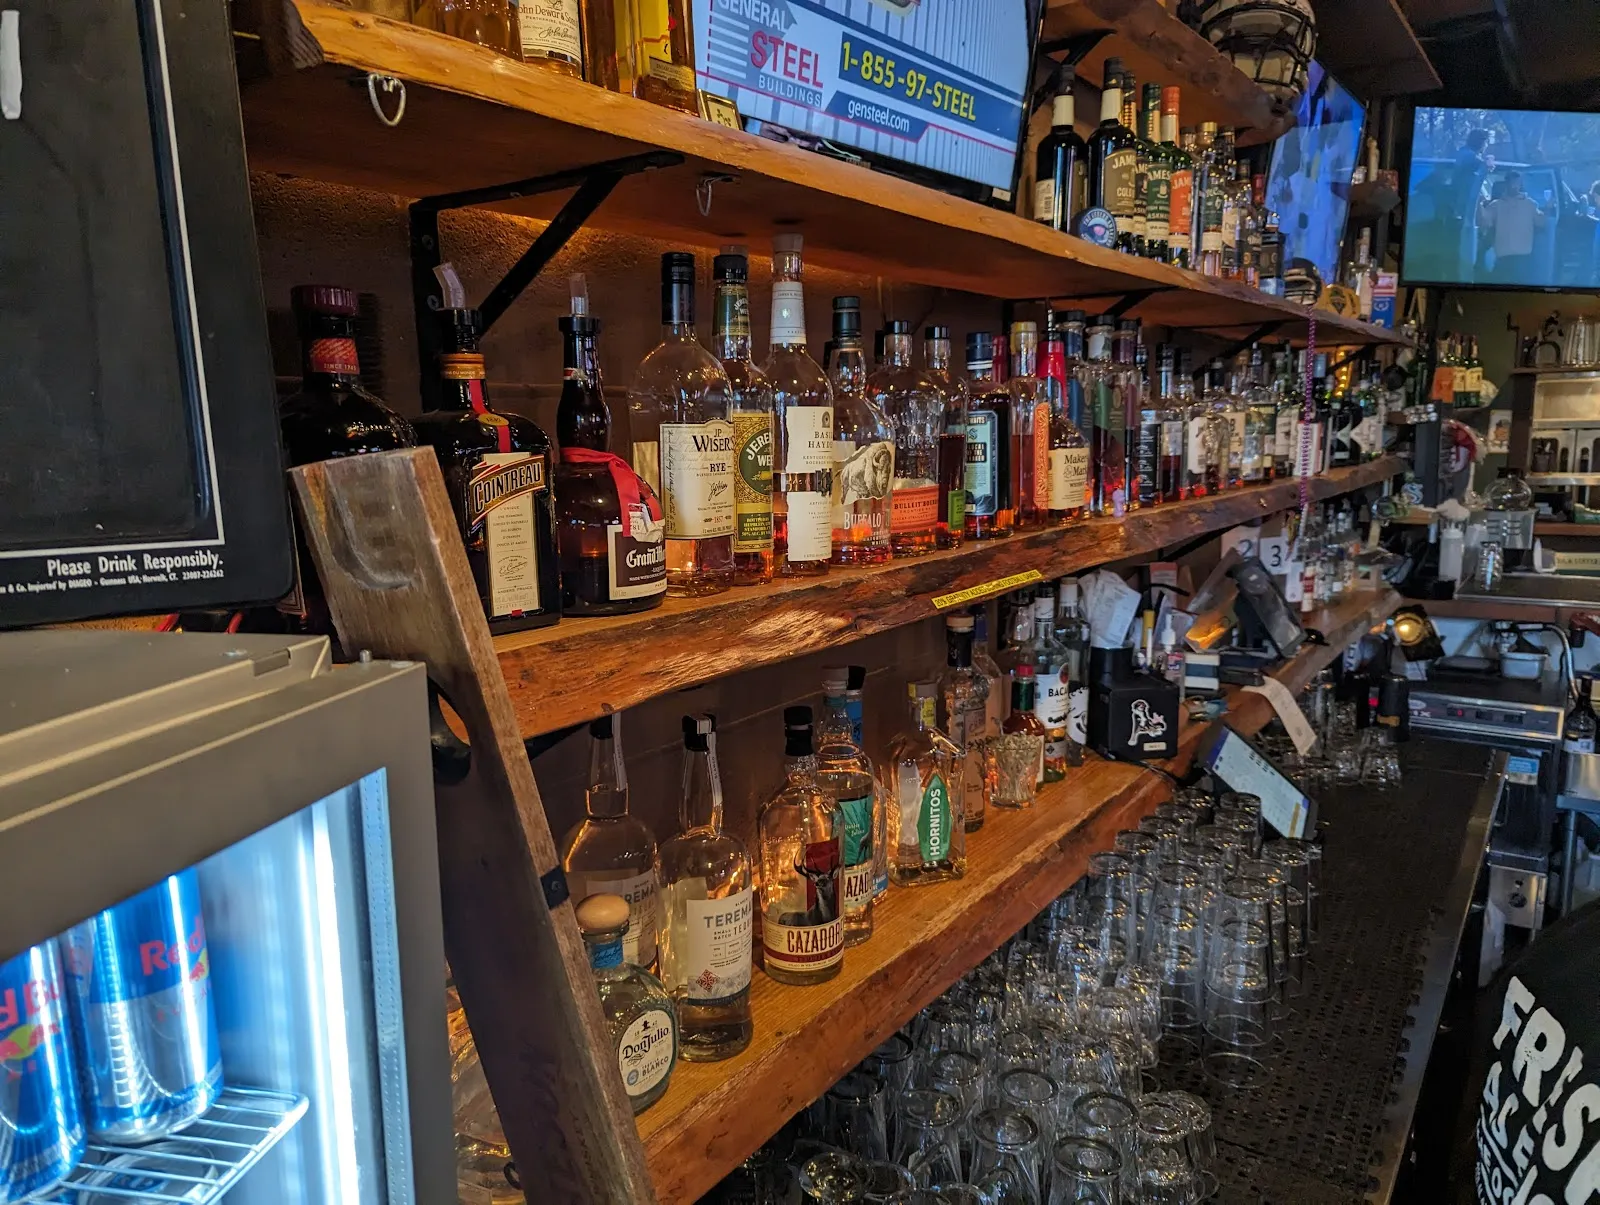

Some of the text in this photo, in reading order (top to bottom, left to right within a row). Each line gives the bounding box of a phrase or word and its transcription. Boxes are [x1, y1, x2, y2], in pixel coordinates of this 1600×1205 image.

[518, 4, 534, 15] ohn
[535, 5, 561, 19] Dewar
[750, 29, 824, 89] STEEL
[758, 74, 822, 108] BUILDINGS
[847, 99, 911, 133] gensteel.com
[714, 429, 722, 438] JP
[709, 462, 727, 473] RYE
[474, 462, 542, 513] COINTREAU
[47, 550, 224, 577] Please Drink Responsibly.
[626, 548, 658, 569] Grand
[1270, 545, 1282, 567] 3
[58, 580, 67, 592] by
[929, 790, 941, 856] HORNITOS
[642, 1055, 669, 1077] BLANCO
